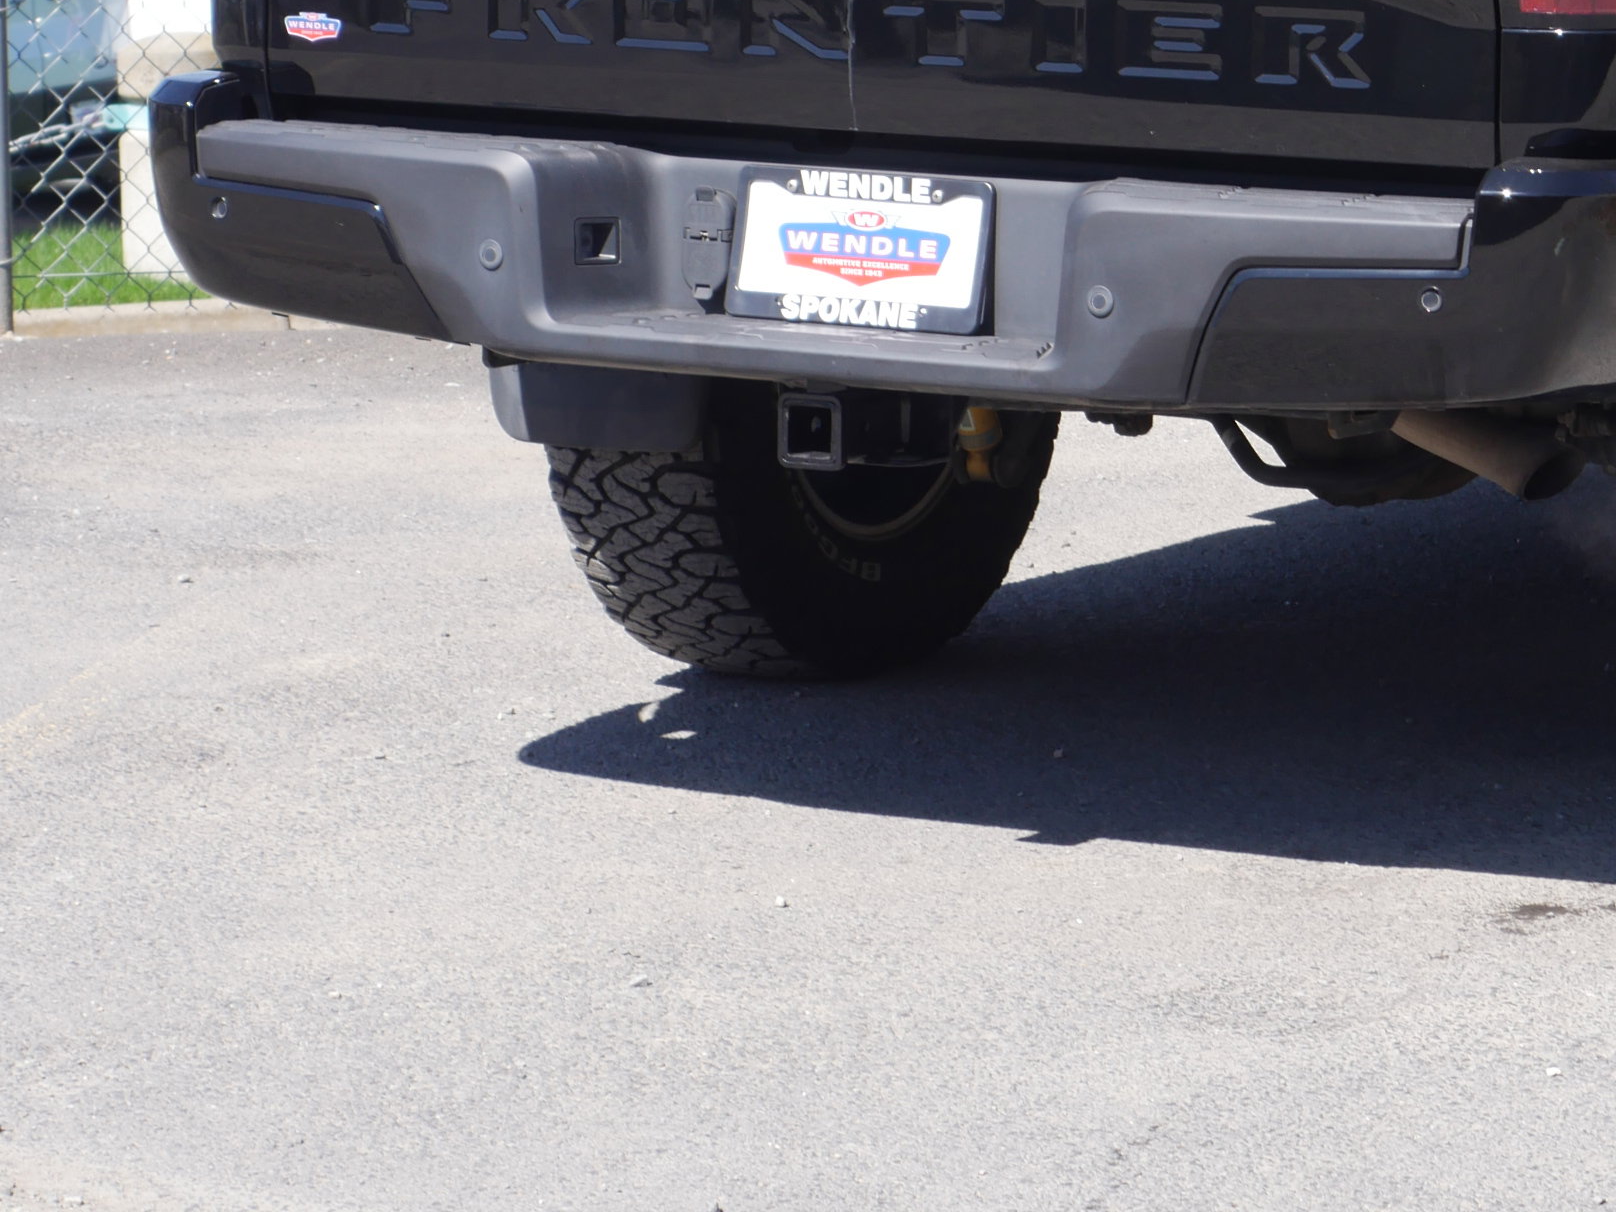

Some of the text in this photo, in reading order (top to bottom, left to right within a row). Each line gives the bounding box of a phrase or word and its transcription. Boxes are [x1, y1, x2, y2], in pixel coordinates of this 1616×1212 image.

[288, 20, 335, 30] WENDLE
[801, 169, 931, 204] WENDLE
[787, 230, 938, 259] WENDLE
[781, 294, 917, 328] SPOKANE
